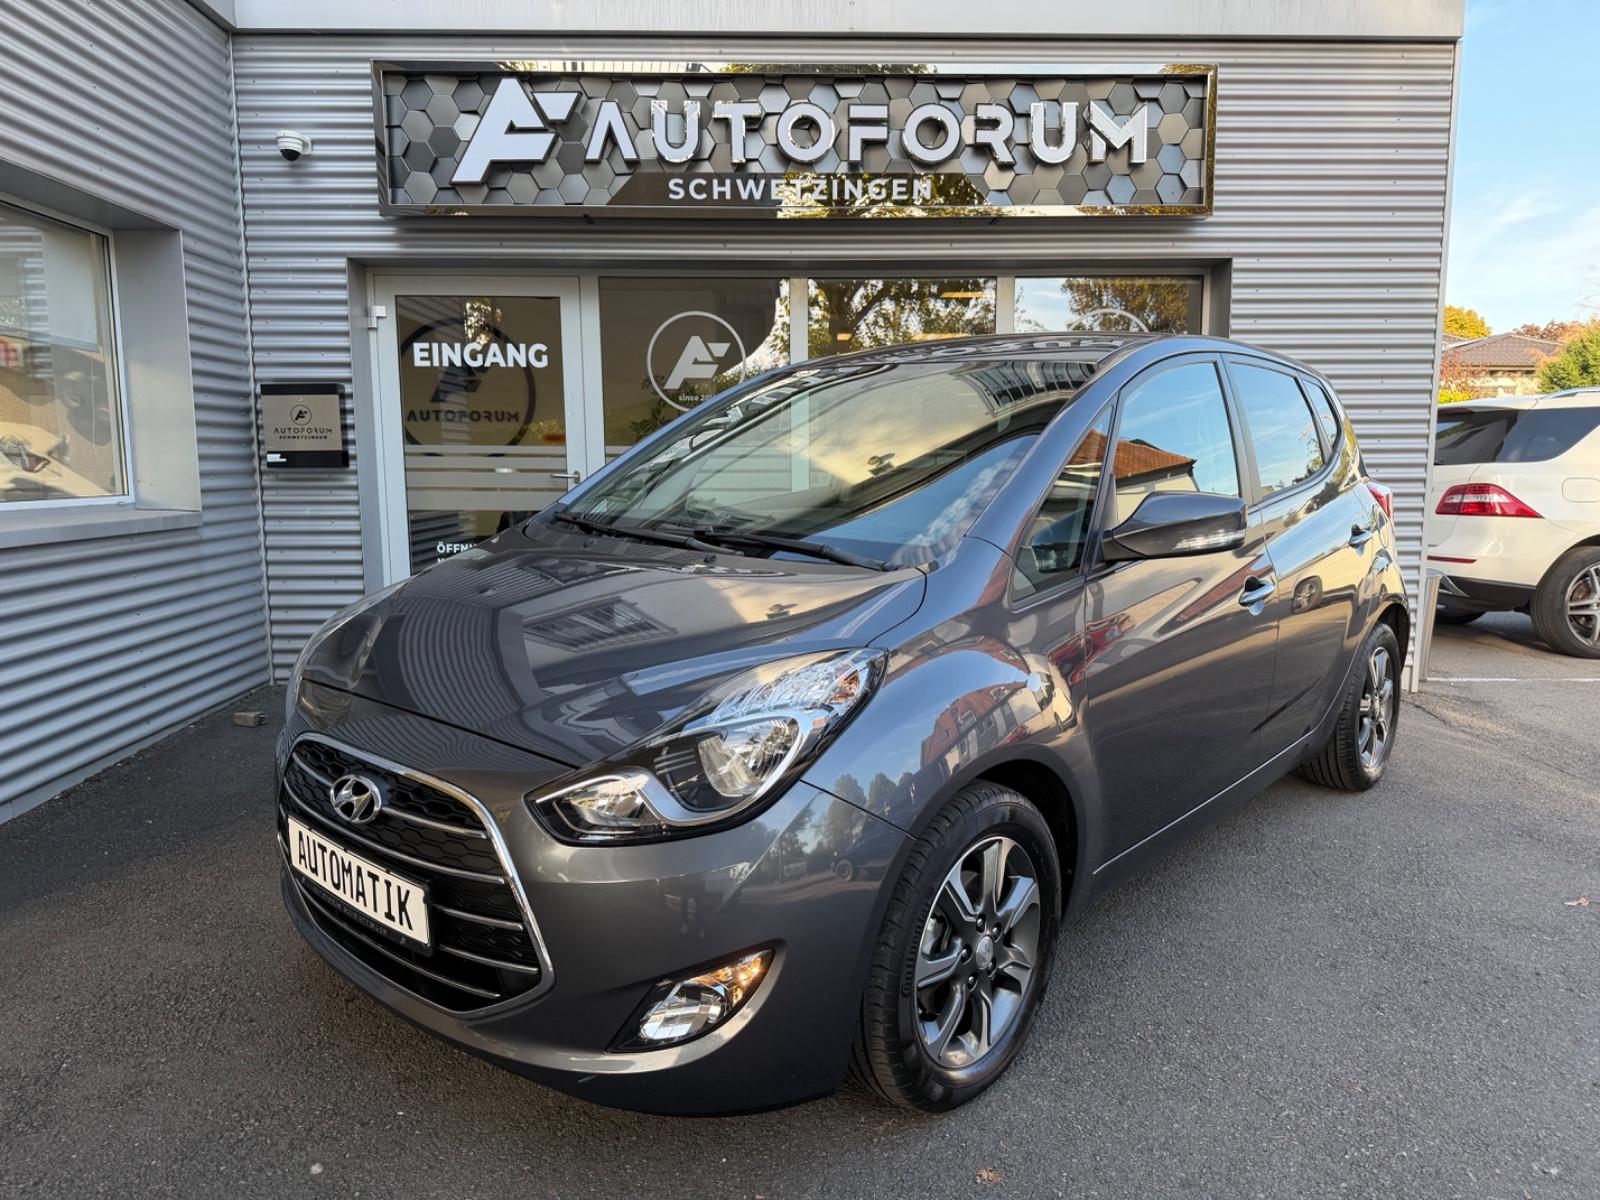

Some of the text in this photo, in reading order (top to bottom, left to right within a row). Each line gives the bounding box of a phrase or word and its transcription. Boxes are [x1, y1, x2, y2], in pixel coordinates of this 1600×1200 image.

[584, 100, 1149, 165] AUTOFORUM
[667, 177, 933, 201] SCHWETZINGEN
[412, 342, 549, 369] EINGANG
[406, 409, 520, 424] AUTOFORUM
[298, 830, 413, 931] AUTOMATIK
